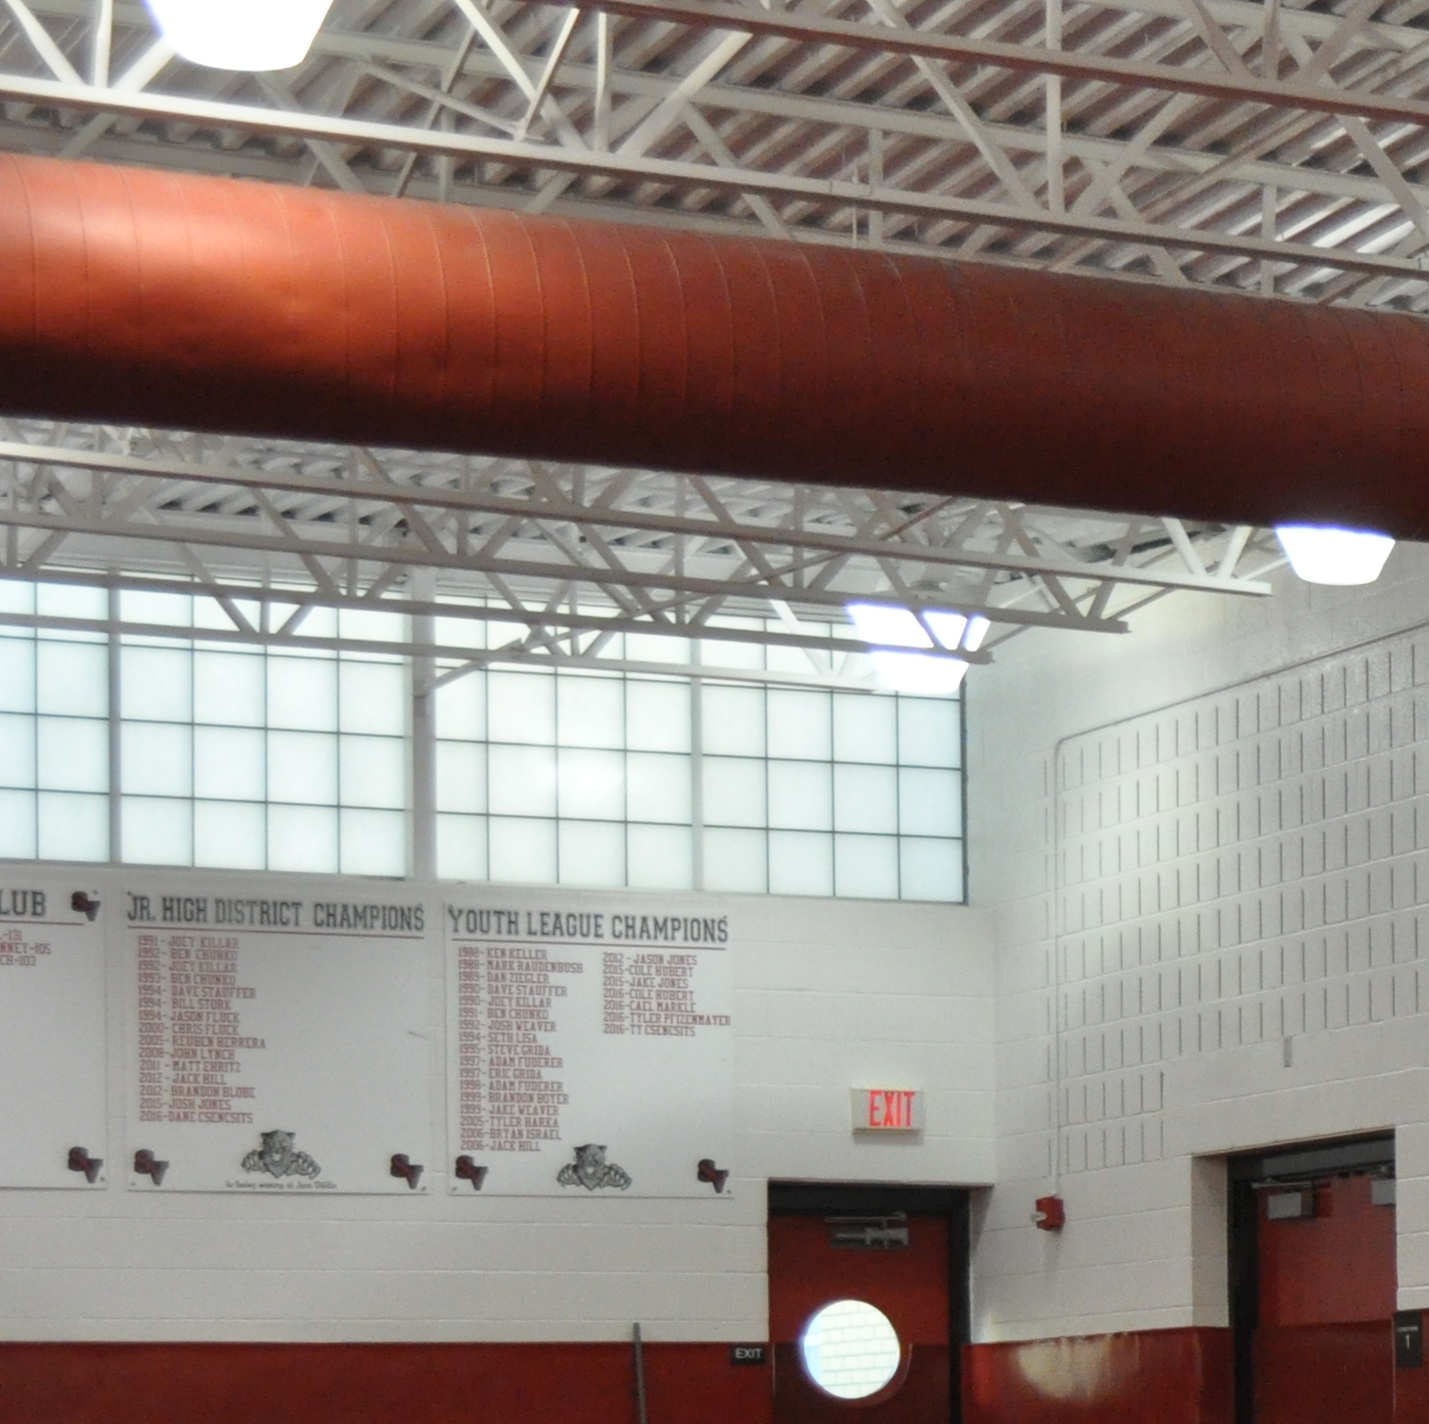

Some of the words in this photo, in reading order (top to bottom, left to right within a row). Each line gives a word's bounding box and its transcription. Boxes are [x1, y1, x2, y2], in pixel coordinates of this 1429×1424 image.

[127, 895, 156, 922] JR.
[162, 897, 207, 924] HIGH
[214, 898, 302, 927] DISTRICT
[313, 902, 425, 931] CHAMPIONS
[448, 907, 520, 936] YOUTH
[526, 911, 604, 938] LEAGUE
[611, 914, 728, 943] CHAMPIONS
[633, 953, 664, 965] JASON
[666, 954, 698, 966] JONES
[487, 971, 506, 983] DAN
[658, 978, 689, 989] JONES
[868, 1089, 916, 1128] EXIT
[735, 1347, 762, 1359] EXIT
